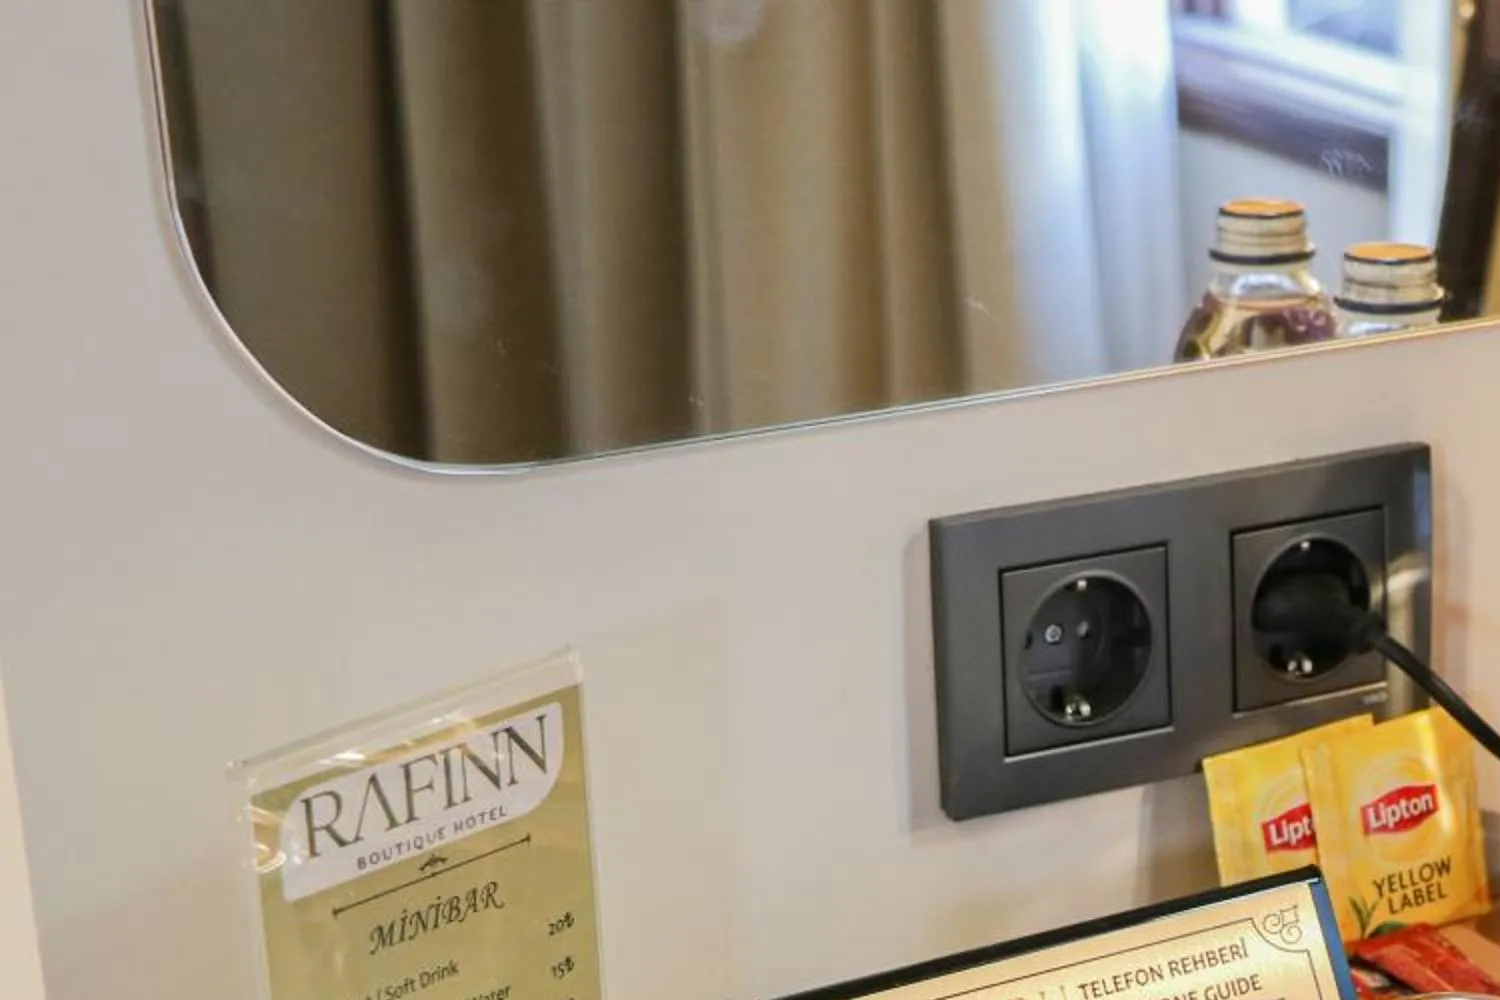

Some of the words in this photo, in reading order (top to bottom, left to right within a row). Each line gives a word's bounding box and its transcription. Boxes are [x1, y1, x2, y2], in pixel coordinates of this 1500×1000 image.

[300, 714, 548, 859] RAFINN
[1366, 792, 1434, 830] Lipton
[357, 827, 446, 871] BOUTIQUE
[453, 804, 508, 833] HOTEL
[1268, 815, 1315, 846] Lipt
[1372, 857, 1451, 898] YELLOW
[1388, 882, 1448, 915] LABEL
[419, 963, 459, 989] Drink
